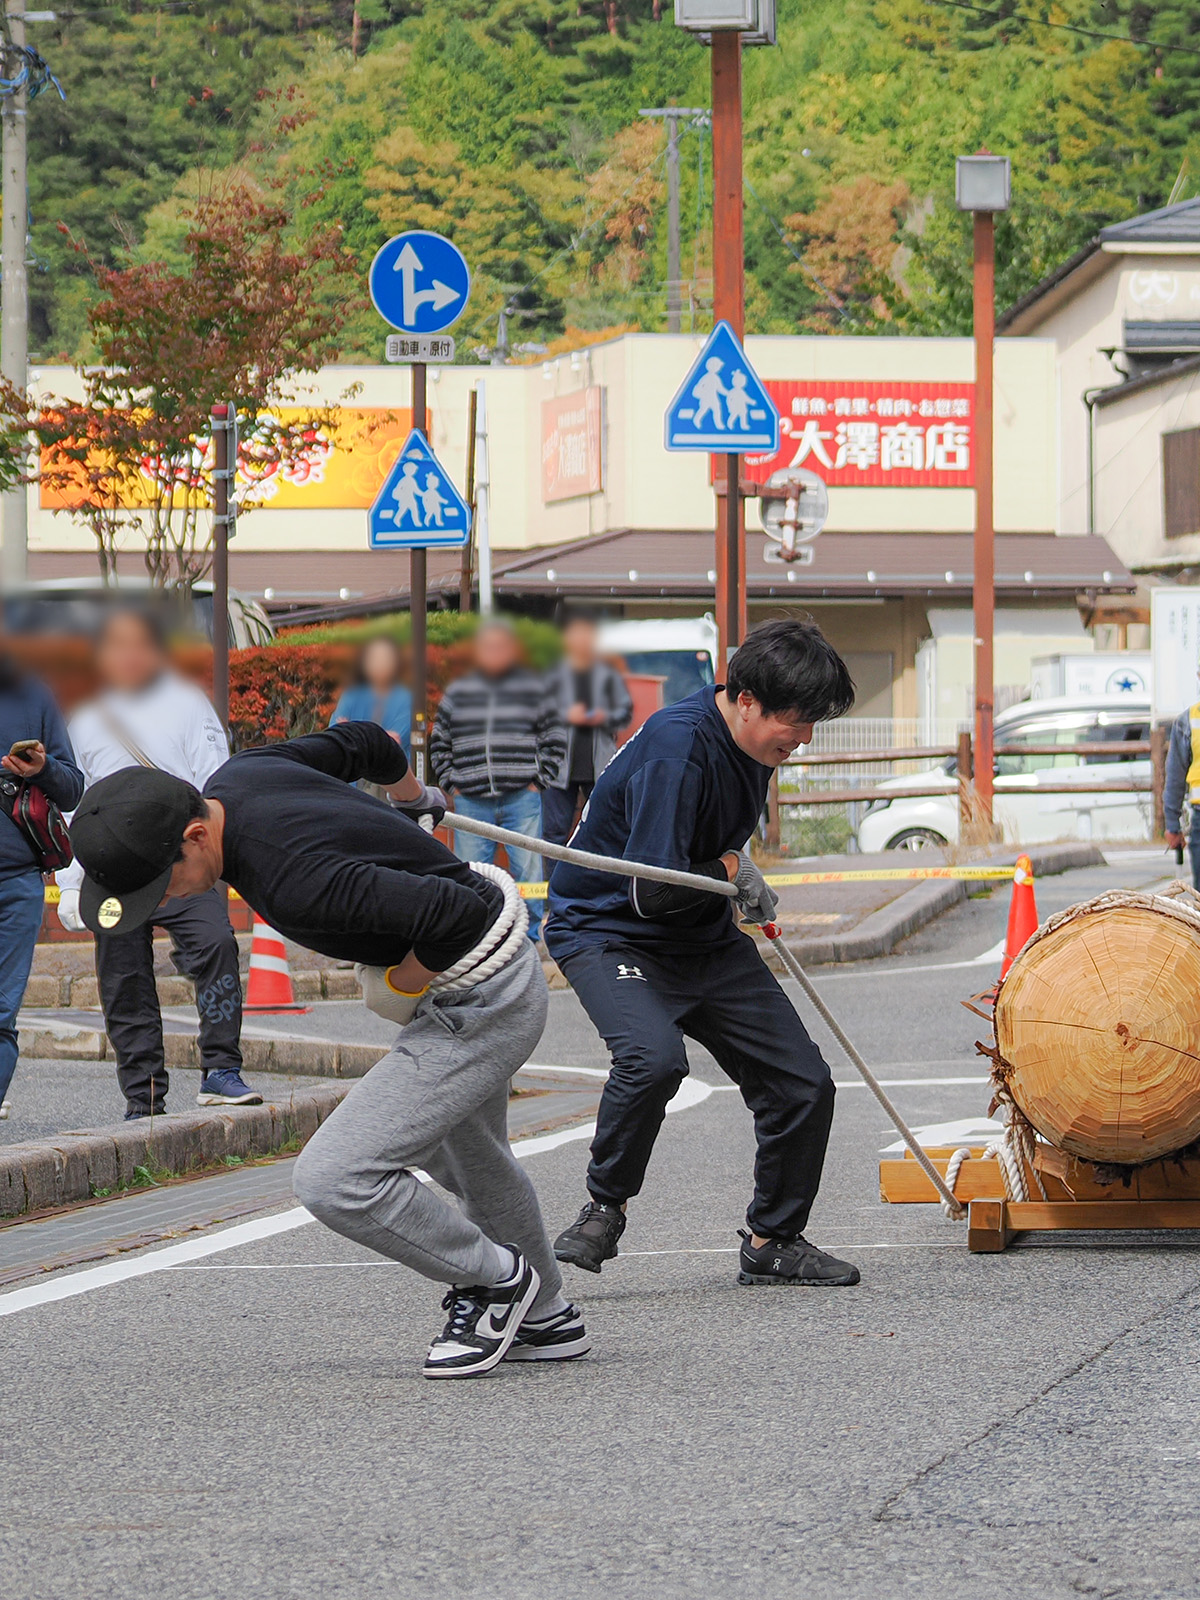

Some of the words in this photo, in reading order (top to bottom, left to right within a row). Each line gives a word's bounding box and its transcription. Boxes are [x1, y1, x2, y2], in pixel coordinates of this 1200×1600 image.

[389, 340, 450, 356] 自動車・原付
[788, 420, 970, 471] 大澤商店
